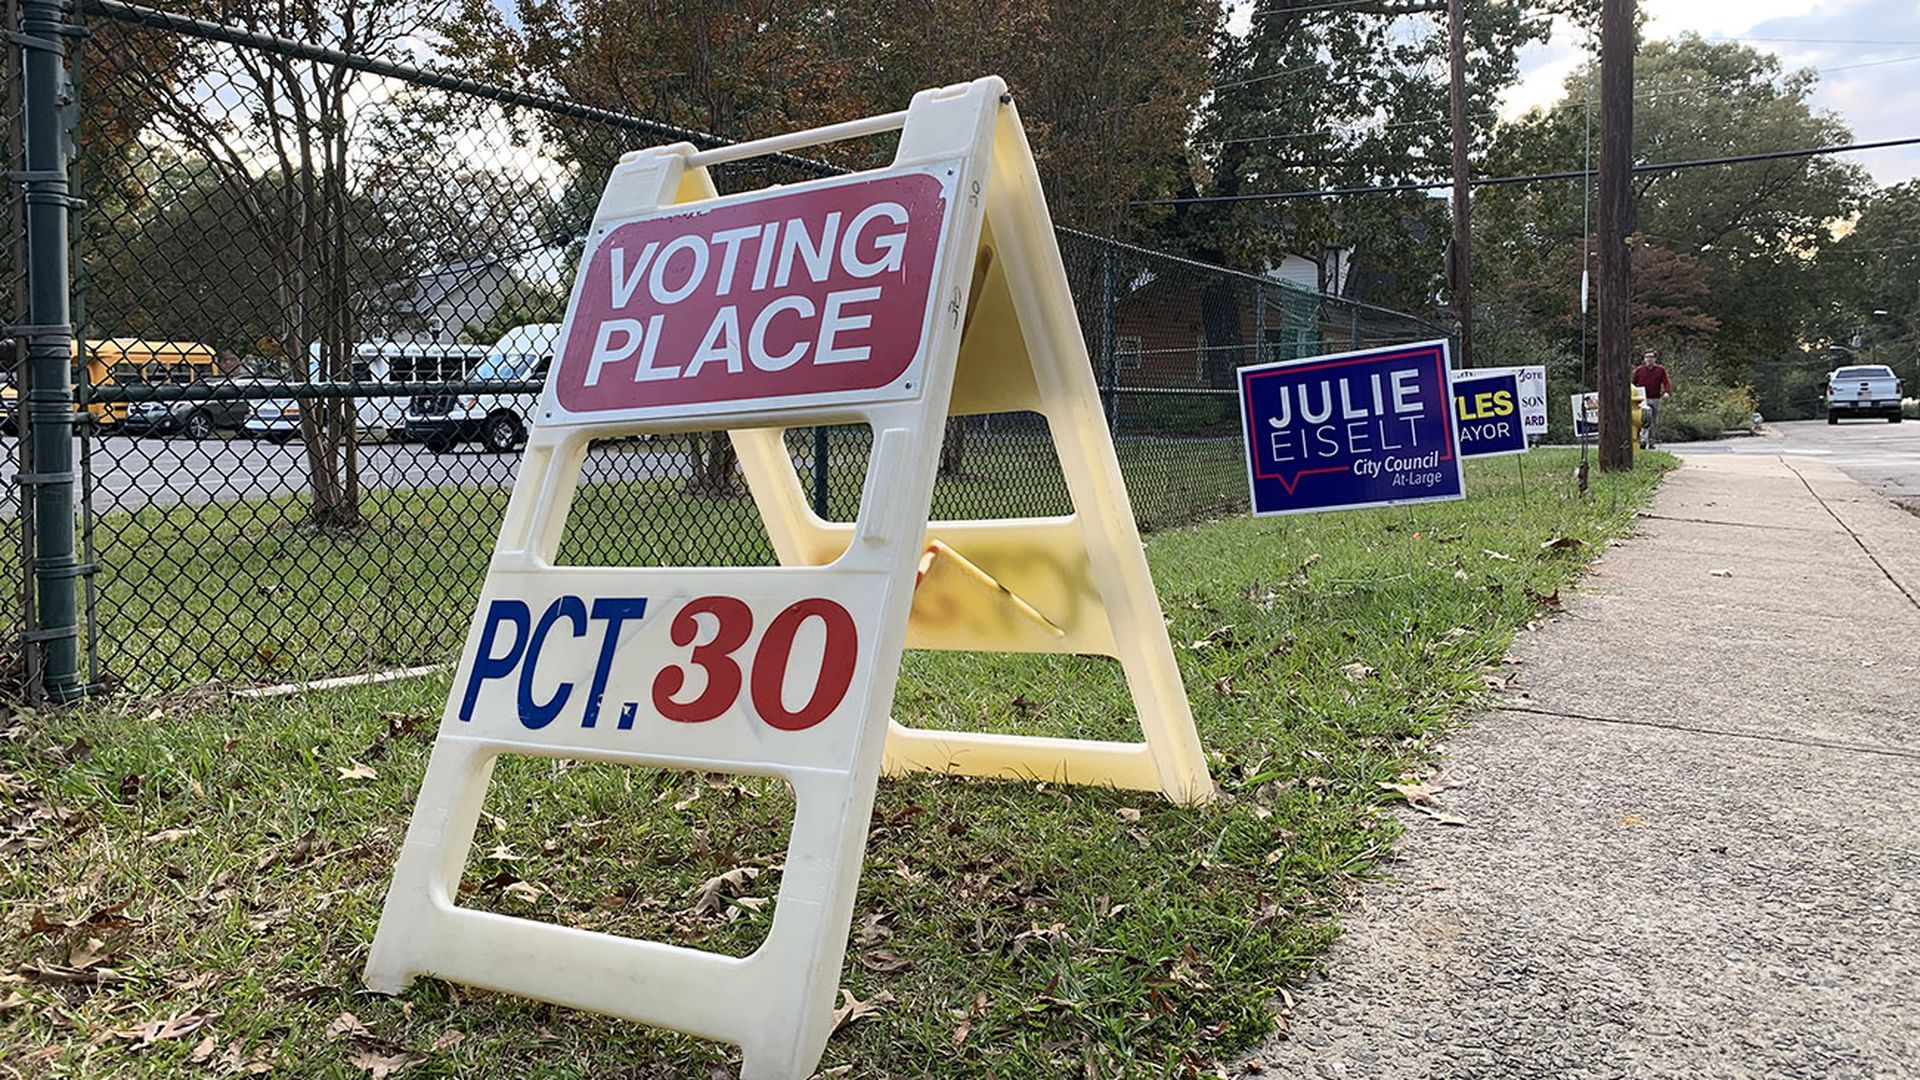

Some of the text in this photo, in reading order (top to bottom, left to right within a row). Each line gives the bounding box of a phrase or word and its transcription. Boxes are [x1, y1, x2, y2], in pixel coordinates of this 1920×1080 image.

[610, 202, 910, 309] VOTING
[583, 286, 882, 388] PLACE
[1268, 368, 1424, 428] JULIE
[1454, 390, 1514, 420] LES
[1521, 396, 1544, 408] SON
[1271, 414, 1425, 462] EISELT
[1459, 422, 1511, 443] AYOR
[1525, 415, 1545, 426] ARD
[1353, 451, 1439, 478] City Council
[458, 595, 859, 732] PCT. 30
